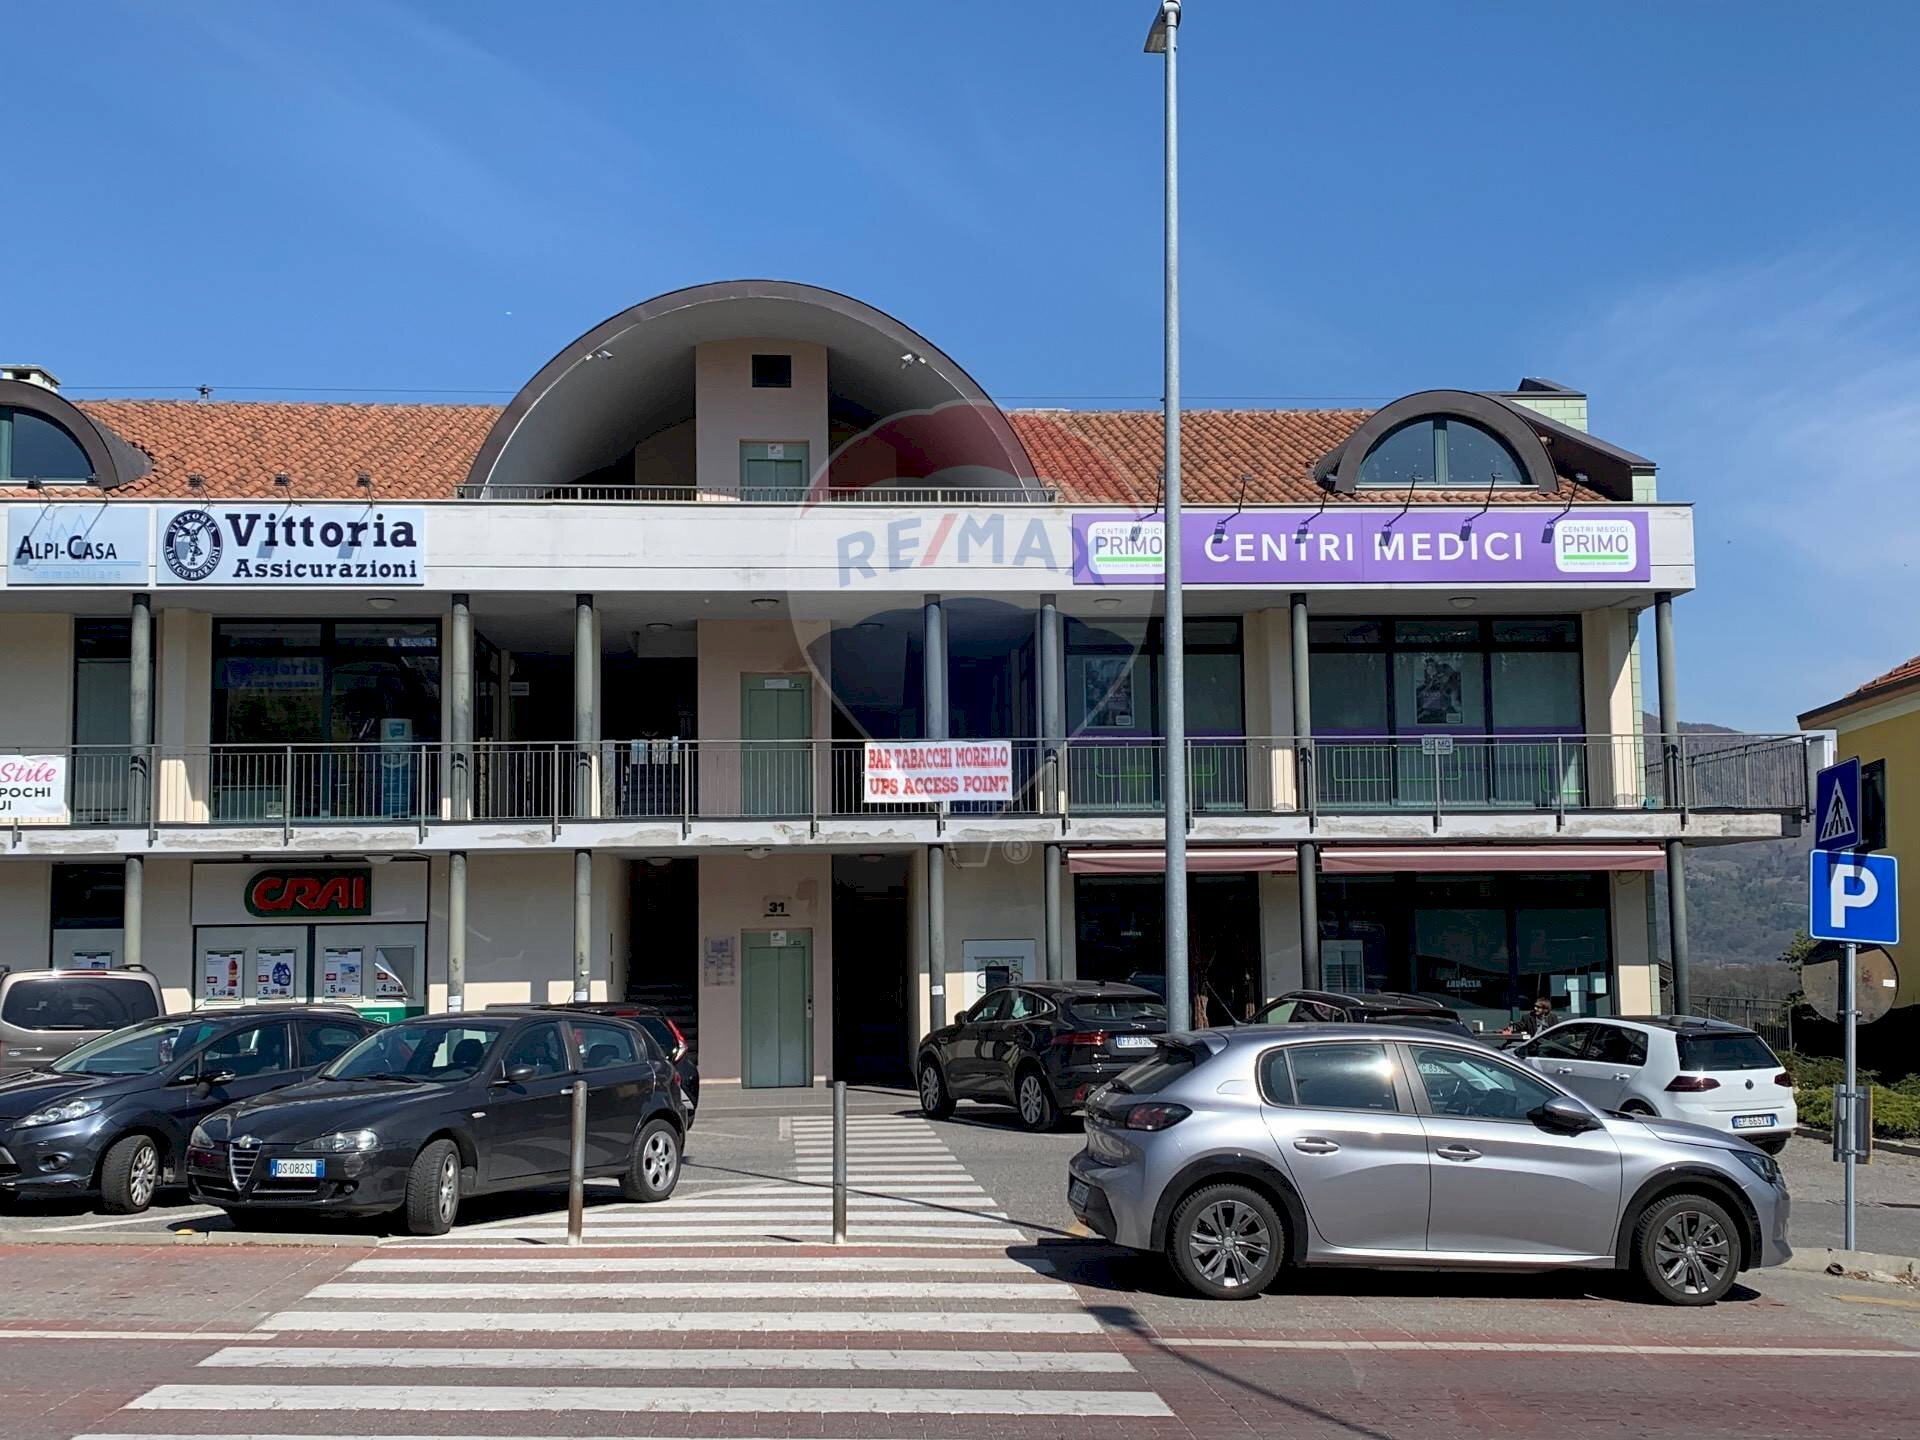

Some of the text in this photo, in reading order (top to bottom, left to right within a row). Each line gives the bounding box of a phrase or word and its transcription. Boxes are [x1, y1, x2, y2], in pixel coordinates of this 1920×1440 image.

[168, 513, 217, 533] VITTORIA
[225, 513, 417, 547] Vittoria
[1095, 536, 1163, 554] PRIMO
[1204, 532, 1522, 563] CENTRI MEDICI
[1562, 534, 1629, 553] PRIMO
[165, 546, 220, 578] ASSICURAZIONI
[232, 559, 417, 577] Assicurazioni
[868, 747, 1008, 769] BAR TABACCHI MORELLO
[0, 763, 56, 782] Stile
[0, 788, 51, 797] POCHI
[869, 775, 1008, 795] UPS ACCESS POINT
[252, 877, 365, 911] CRAI
[1831, 864, 1878, 928] P
[769, 902, 785, 912] 31
[277, 1163, 315, 1174] DS 082SL
